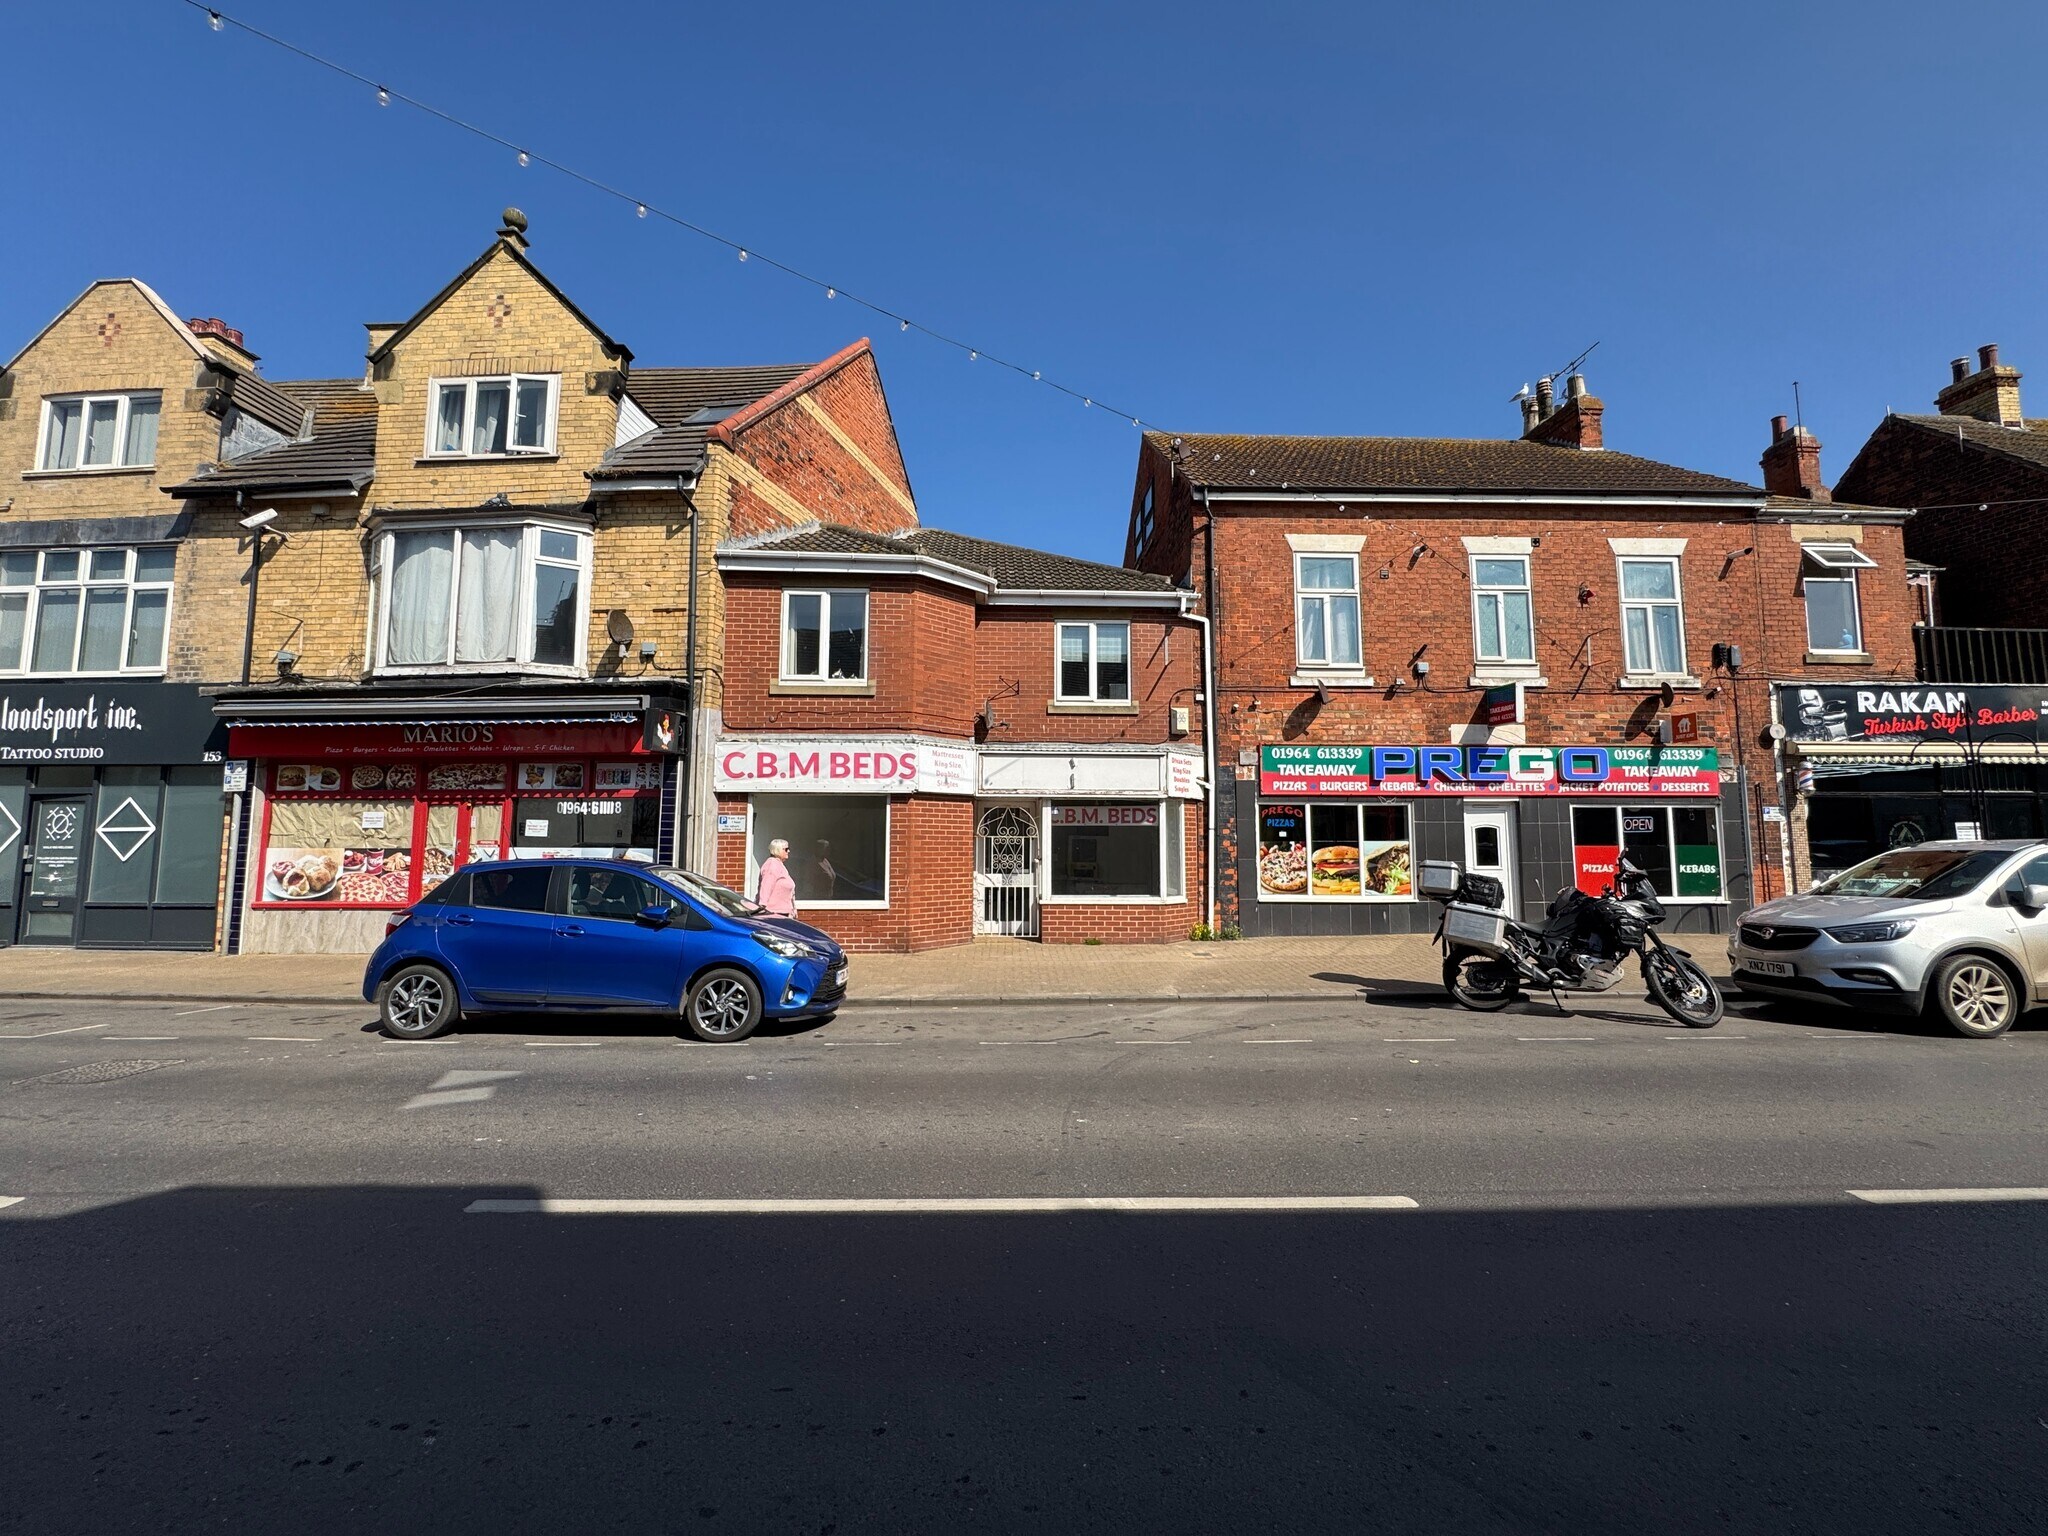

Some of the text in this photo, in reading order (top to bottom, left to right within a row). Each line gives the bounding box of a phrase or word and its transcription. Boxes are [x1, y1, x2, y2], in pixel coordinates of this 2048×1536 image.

[1857, 691, 1966, 714] RAKAN
[1, 694, 142, 743] loodsport inc.
[1863, 715, 1929, 736] Turkish
[1977, 705, 2039, 726] Barber
[404, 725, 494, 743] MARIO'S
[1, 747, 104, 759] TATTOO STUDIO
[503, 743, 524, 752] Wraps
[549, 743, 575, 751] Chicken
[1271, 747, 1363, 759] 01964 613339
[203, 751, 222, 762] 153
[932, 750, 964, 760] Mattresses
[1614, 749, 1704, 761] 01964 613339
[723, 752, 917, 780] C.B.M BEDS
[934, 760, 948, 769] King
[1277, 764, 1357, 776] TAKEAWAY
[1371, 746, 1610, 782] PREGO
[936, 770, 960, 778] Doubles
[1622, 765, 1700, 778] TAKEAWAY
[1272, 781, 1710, 793] PIZZAS BURGERS KEBABS CHICKEN OMELETTES JACKET POTATOES DESSERTS
[1107, 808, 1157, 824] BEDS
[1261, 806, 1304, 818] PREGO
[1267, 818, 1295, 827] PIZZAS
[1623, 819, 1653, 831] OPEN
[1582, 864, 1615, 873] PIZZAS
[1679, 864, 1717, 873] KEBABS
[1748, 960, 1786, 974] XNZ 1791
